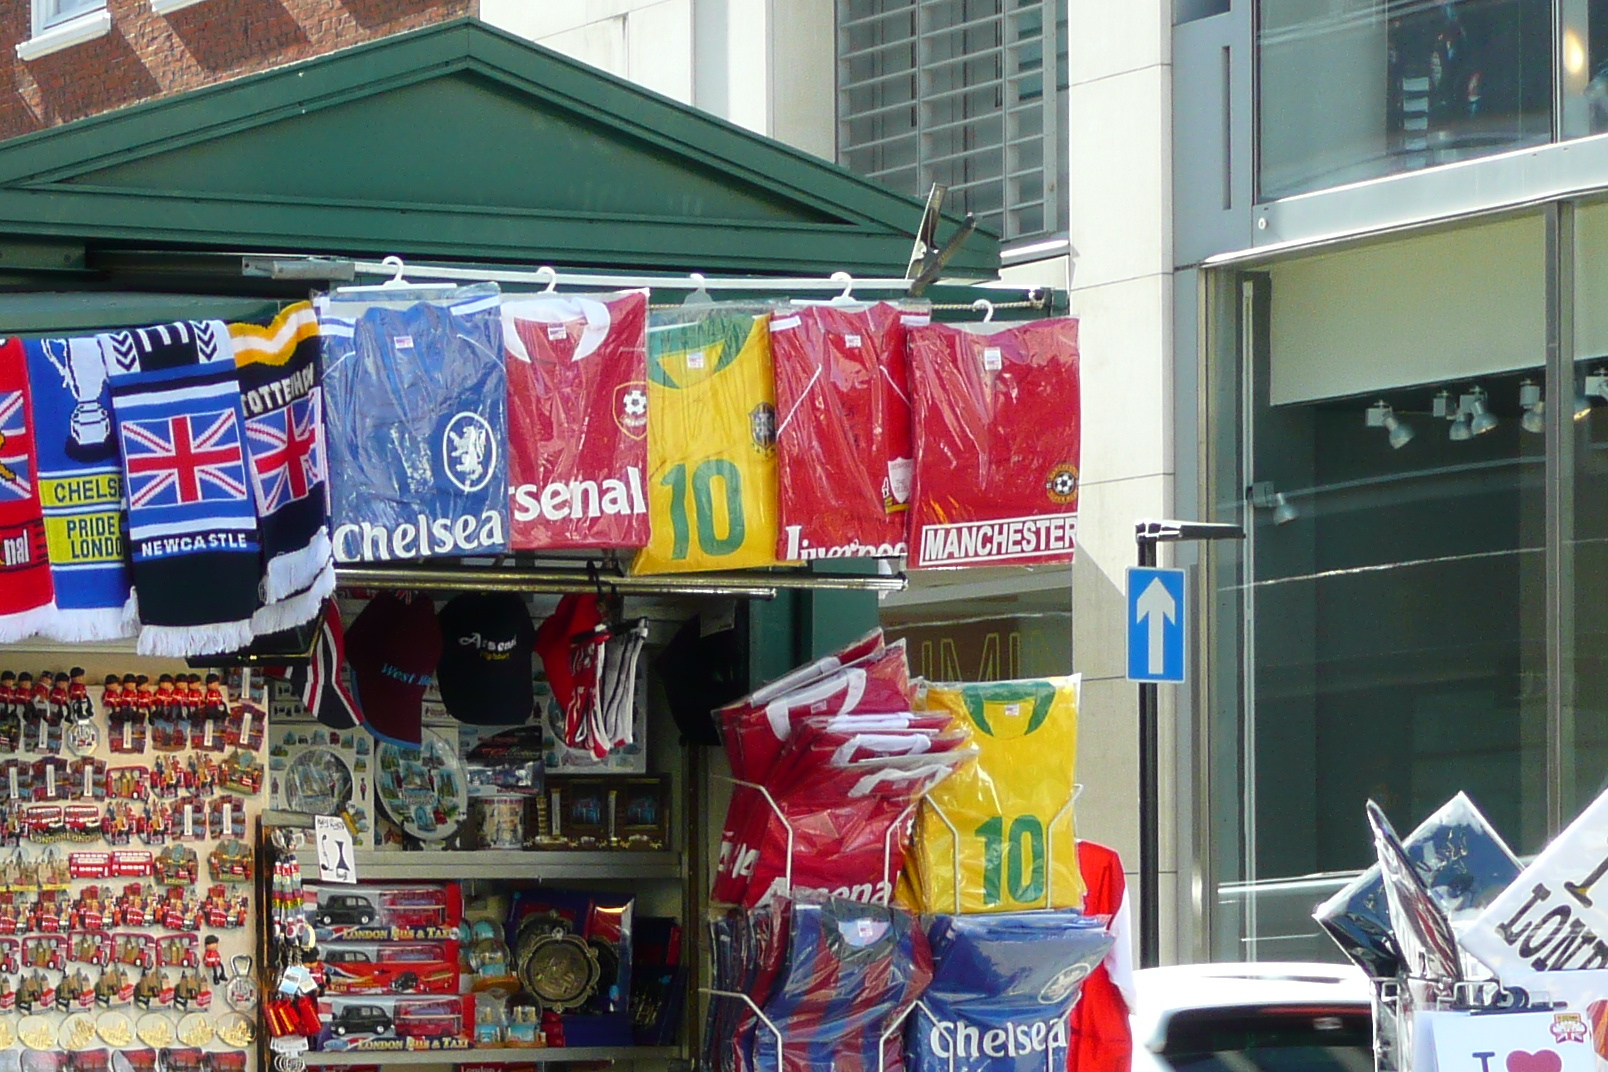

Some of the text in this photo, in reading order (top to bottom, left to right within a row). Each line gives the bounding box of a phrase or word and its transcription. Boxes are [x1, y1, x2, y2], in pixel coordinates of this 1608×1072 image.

[509, 465, 647, 523] senal
[660, 458, 746, 562] 10
[66, 514, 116, 540] PRIDE
[140, 531, 248, 558] NEWCASTLE
[330, 509, 505, 563] Chelsea
[924, 519, 1078, 560] MANCHESTER
[380, 662, 416, 685] West
[974, 814, 1045, 907] 10
[343, 925, 425, 941] LONDON BUS &
[357, 1035, 469, 1051] LONDON BUS & TAXI
[930, 1018, 1068, 1059] Chelsea
